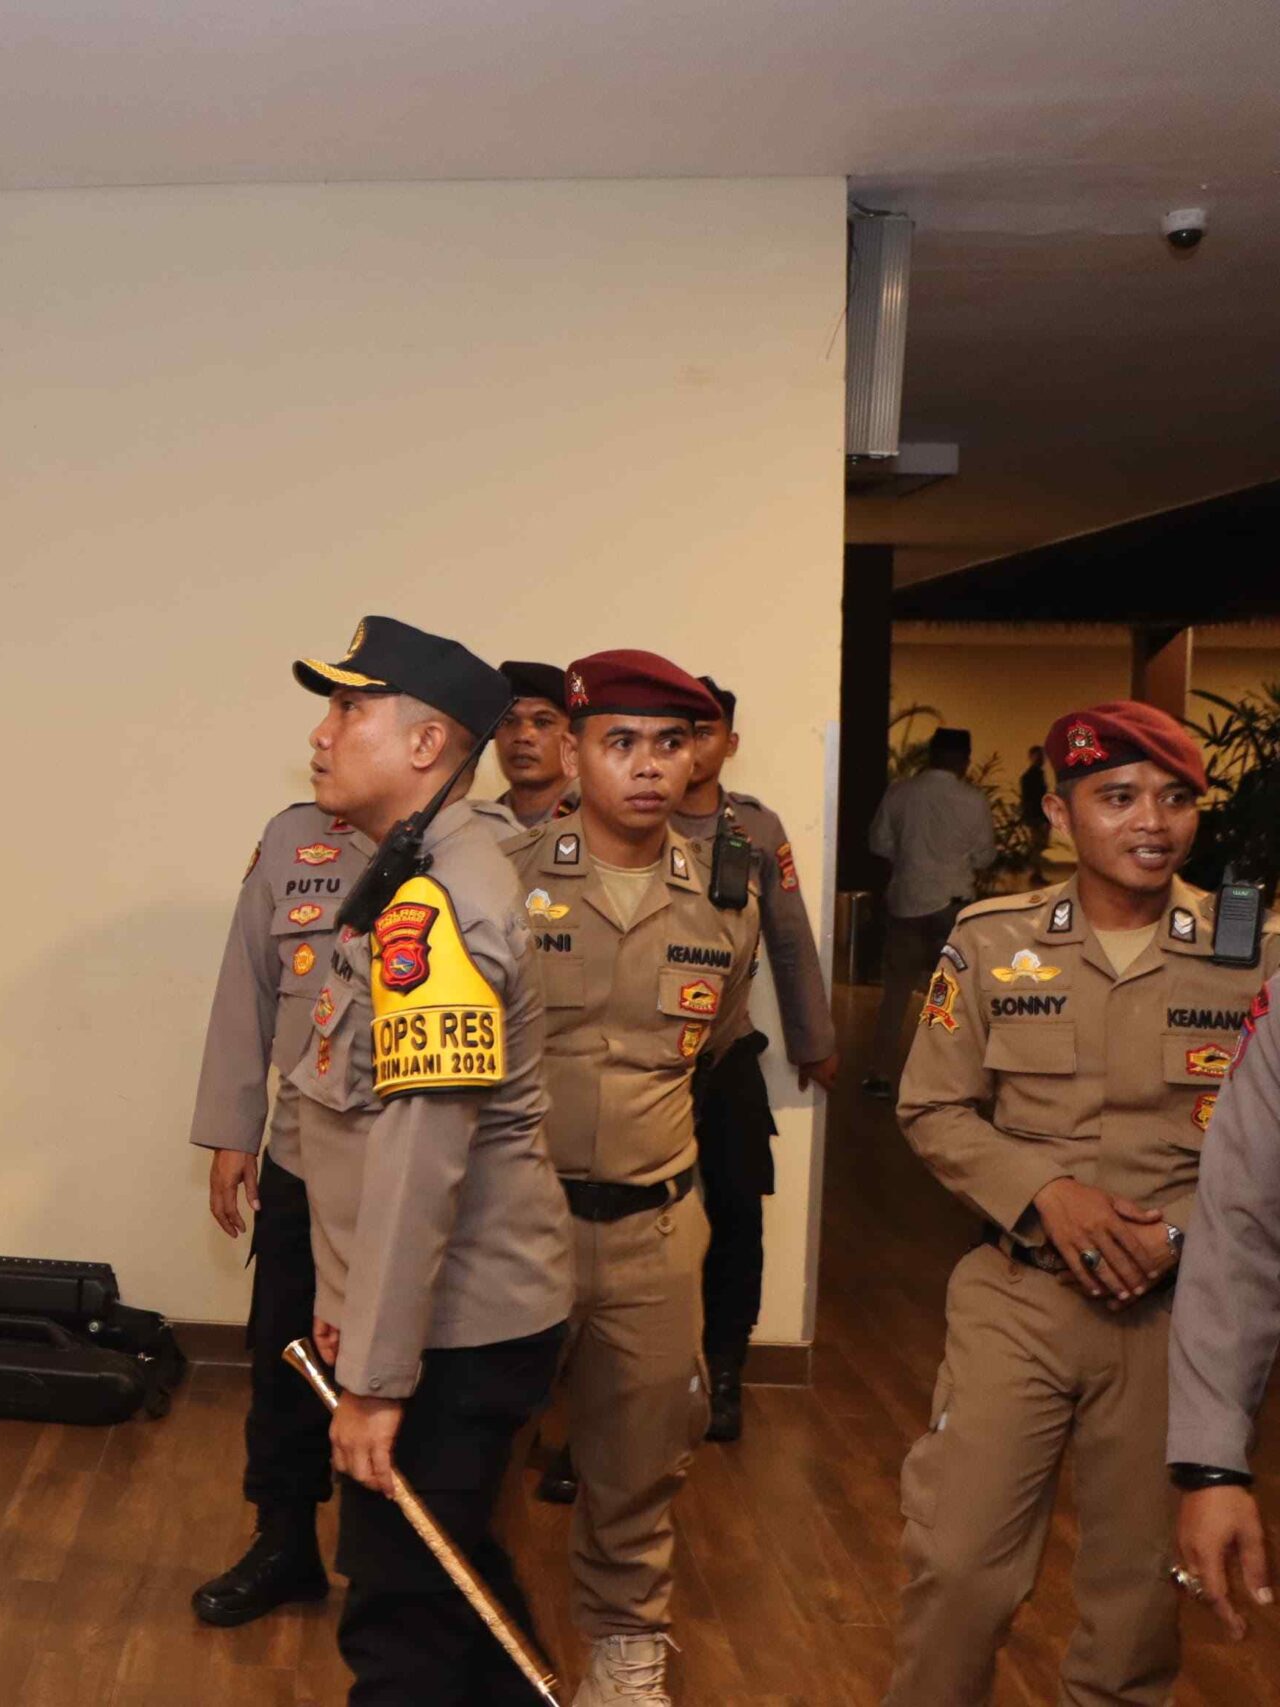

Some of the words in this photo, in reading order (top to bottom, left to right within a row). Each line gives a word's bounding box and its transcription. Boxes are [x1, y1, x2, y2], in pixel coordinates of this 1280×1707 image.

[286, 878, 340, 896] PUTU
[991, 996, 1067, 1016] SONNY
[380, 1014, 427, 1056] OPS
[440, 1012, 495, 1049] RES
[380, 1054, 442, 1080] RINJANI
[452, 1052, 496, 1074] 2024
